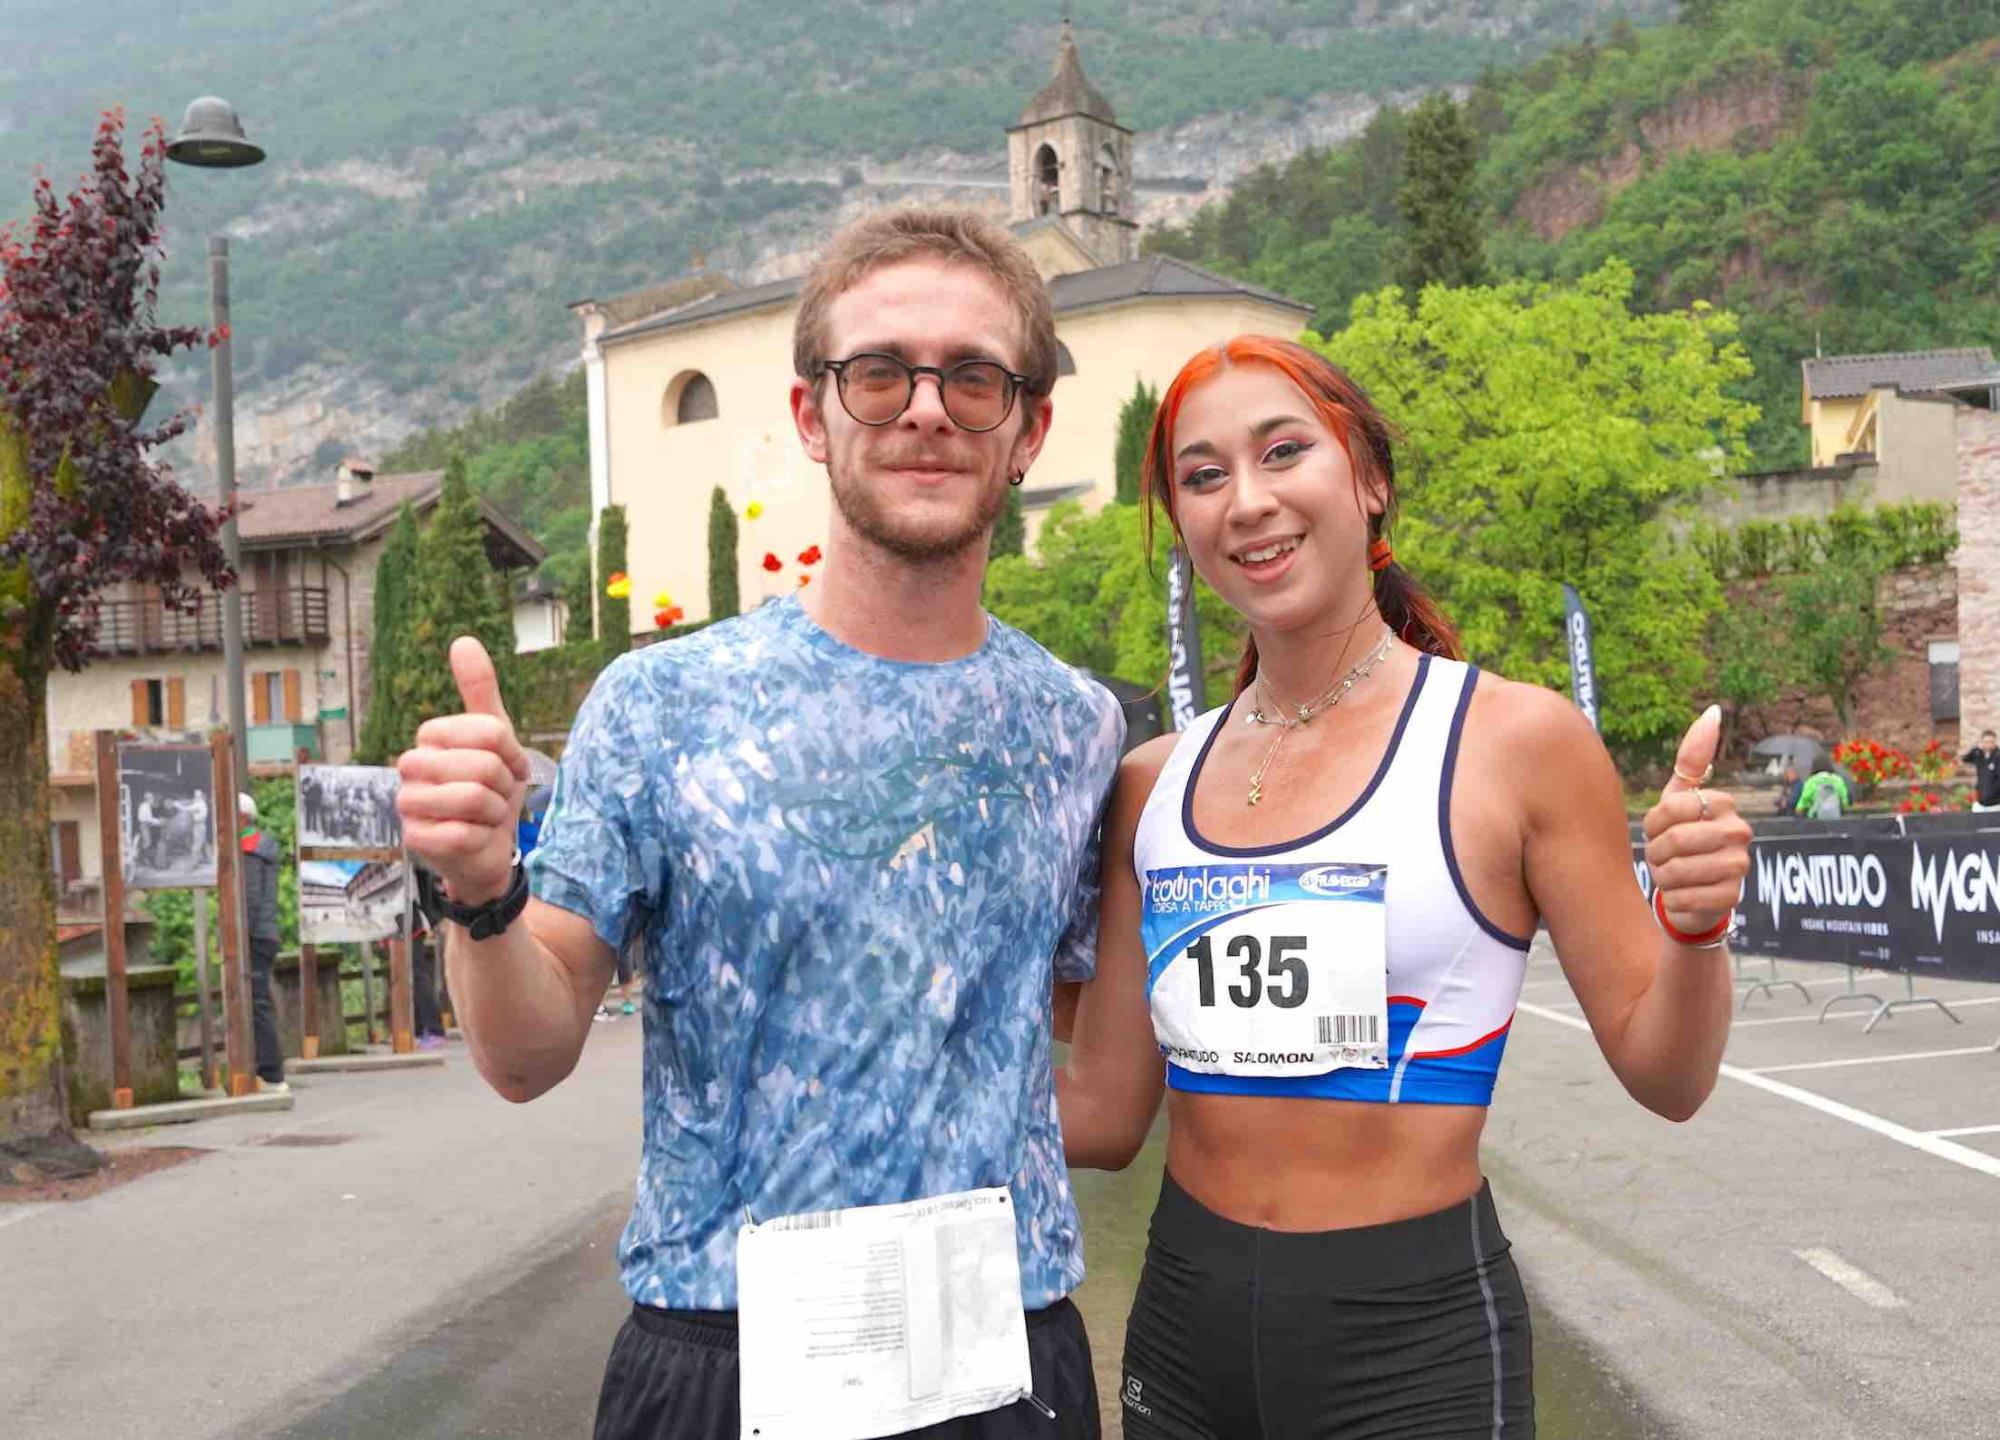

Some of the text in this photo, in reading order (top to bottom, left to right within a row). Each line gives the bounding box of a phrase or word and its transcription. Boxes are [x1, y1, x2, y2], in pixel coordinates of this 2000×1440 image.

[1152, 866, 1270, 907] tourlaghi
[1756, 846, 1887, 930] MAGNITUDO
[1186, 934, 1309, 1008] 135
[1233, 1052, 1314, 1064] SALOMON
